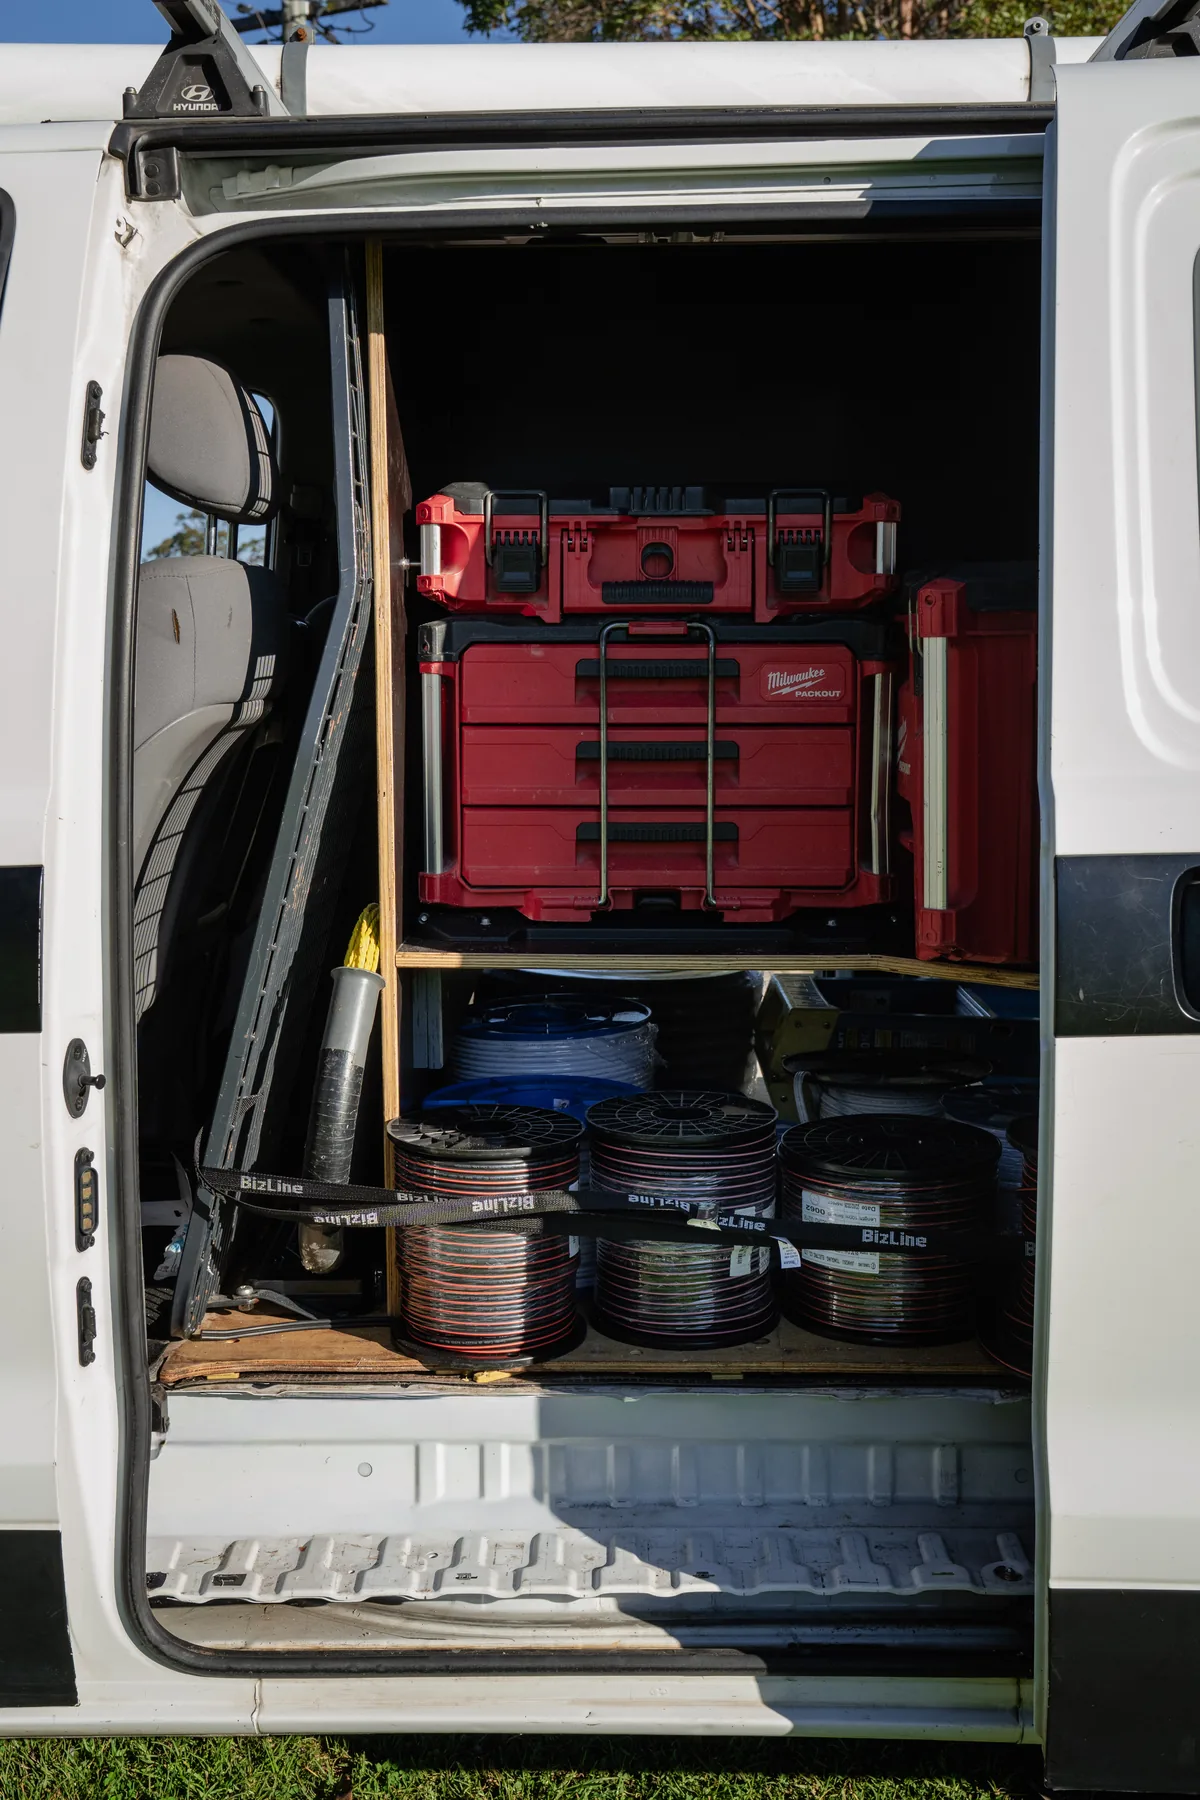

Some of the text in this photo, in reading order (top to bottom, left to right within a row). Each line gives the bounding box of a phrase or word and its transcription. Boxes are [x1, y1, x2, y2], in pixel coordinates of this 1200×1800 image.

[173, 103, 221, 111] HYUNDAI
[767, 667, 826, 691] Milwaukee
[795, 690, 841, 698] PACKOUT
[240, 1175, 304, 1194] BizLine
[396, 1192, 459, 1203] BizLi
[471, 1195, 535, 1213] BizLine
[628, 1194, 690, 1213] BizLine
[805, 1204, 826, 1216] 0062
[313, 1212, 379, 1226] BizLine
[716, 1215, 766, 1231] zLine
[861, 1229, 927, 1248] BizLine
